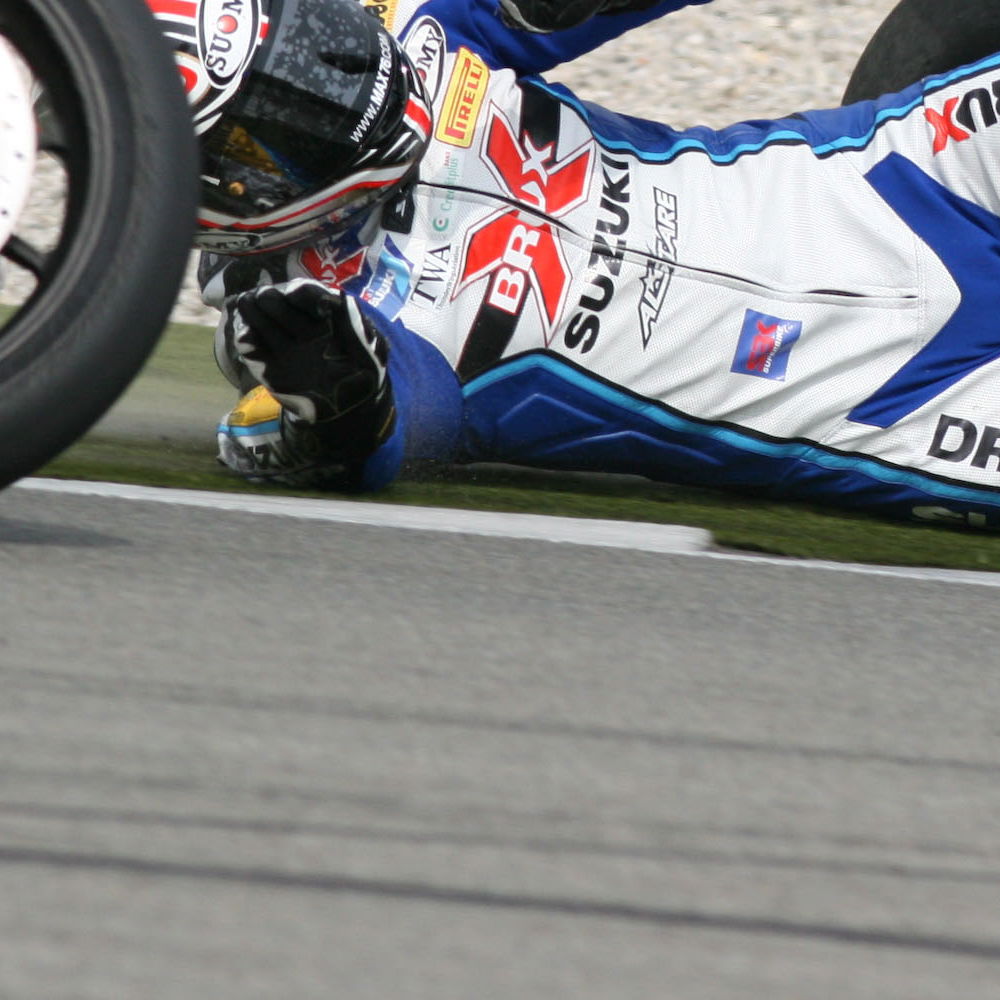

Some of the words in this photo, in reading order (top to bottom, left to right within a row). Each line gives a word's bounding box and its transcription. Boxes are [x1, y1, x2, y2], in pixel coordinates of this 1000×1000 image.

[444, 57, 483, 140] PIRELLI
[411, 243, 451, 304] TWA
[564, 153, 631, 355] SUZUKI
